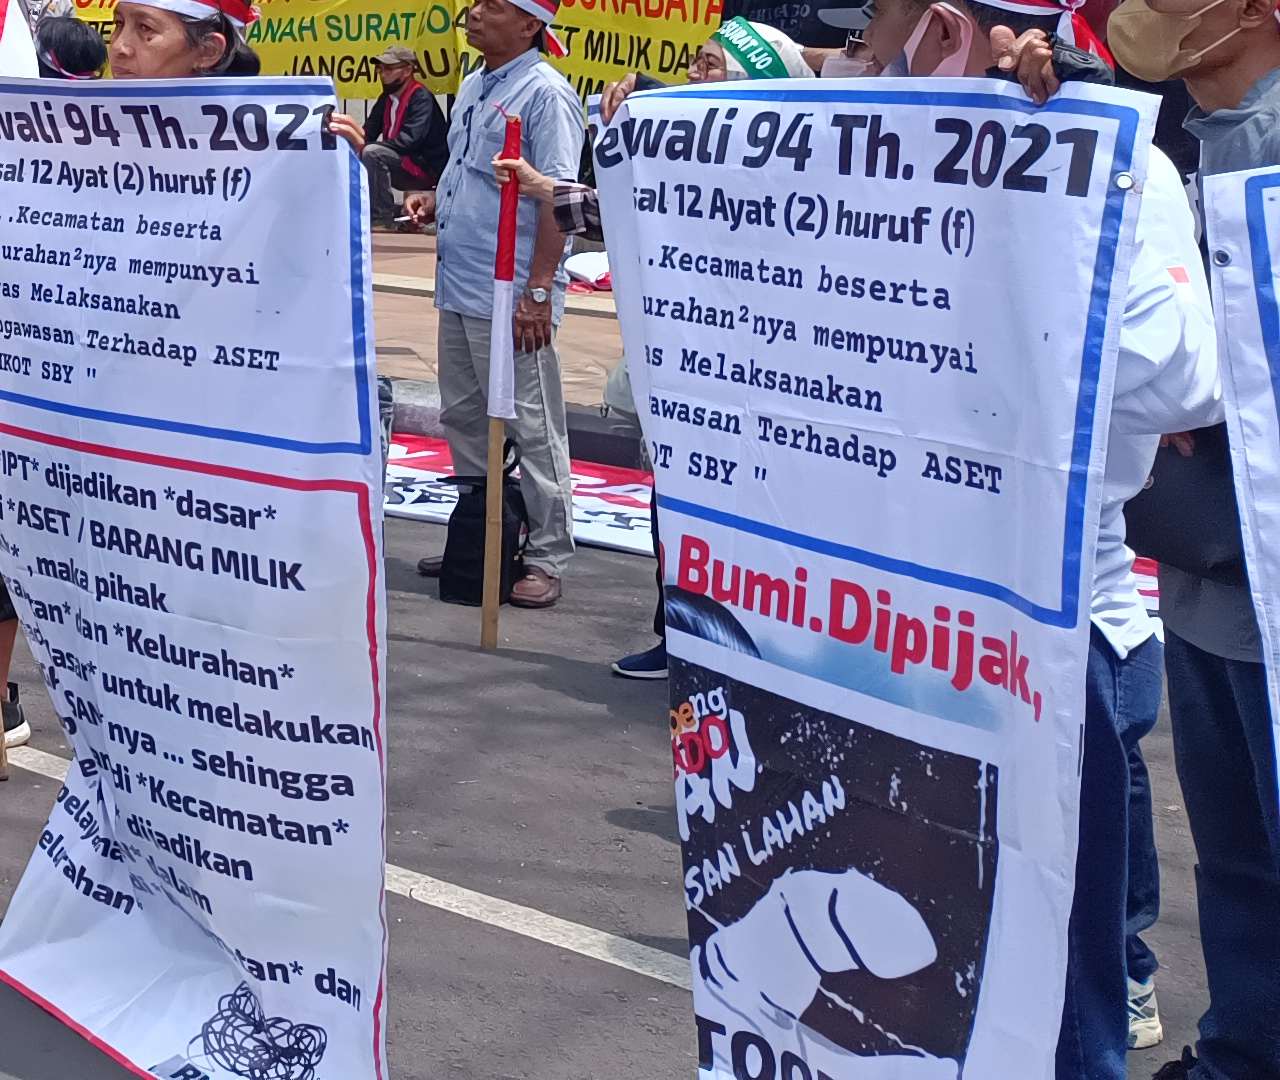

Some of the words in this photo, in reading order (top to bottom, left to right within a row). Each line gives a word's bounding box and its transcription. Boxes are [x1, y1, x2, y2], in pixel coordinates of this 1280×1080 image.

[247, 16, 317, 43] ANAH
[325, 12, 416, 42] SURAT
[585, 29, 651, 71] MILIK
[62, 102, 120, 147] 94
[122, 104, 198, 151] Th.
[201, 104, 338, 151] 2021
[741, 111, 814, 172] 94
[831, 114, 915, 181] Th.
[933, 117, 1099, 197] 2021
[30, 160, 53, 186] 12
[57, 163, 108, 194] Ayat
[113, 162, 144, 195] (2)
[149, 166, 217, 196] huruf
[222, 166, 252, 202] (f)
[136, 216, 223, 242] beserta
[674, 184, 703, 219] 12
[708, 189, 777, 233] Ayat
[783, 192, 829, 240] (2)
[835, 200, 931, 245] huruf
[940, 206, 975, 258] (f)
[128, 257, 260, 286] mempunyai
[817, 266, 951, 311] beserta
[31, 283, 181, 320] Melaksanakan
[41, 355, 74, 384] SBY
[86, 329, 197, 366] Terhadap
[213, 345, 280, 371] ASET
[813, 323, 977, 374] mempunyai
[680, 347, 884, 412] Melaksanakan
[688, 452, 738, 487] SBY
[758, 416, 897, 477] Terhadap
[921, 452, 1003, 494] ASET
[45, 461, 158, 511] dijadikan
[91, 520, 204, 572] BARANG
[211, 549, 306, 592] MILIK
[36, 557, 89, 591] maka
[95, 572, 169, 613] pihak
[75, 607, 108, 645] dan
[102, 672, 181, 715] untuk
[188, 695, 375, 752] melakukan
[108, 721, 156, 756] nya
[192, 748, 355, 802] sehingga
[742, 775, 845, 865] LAHAN
[315, 968, 361, 1012] dan
